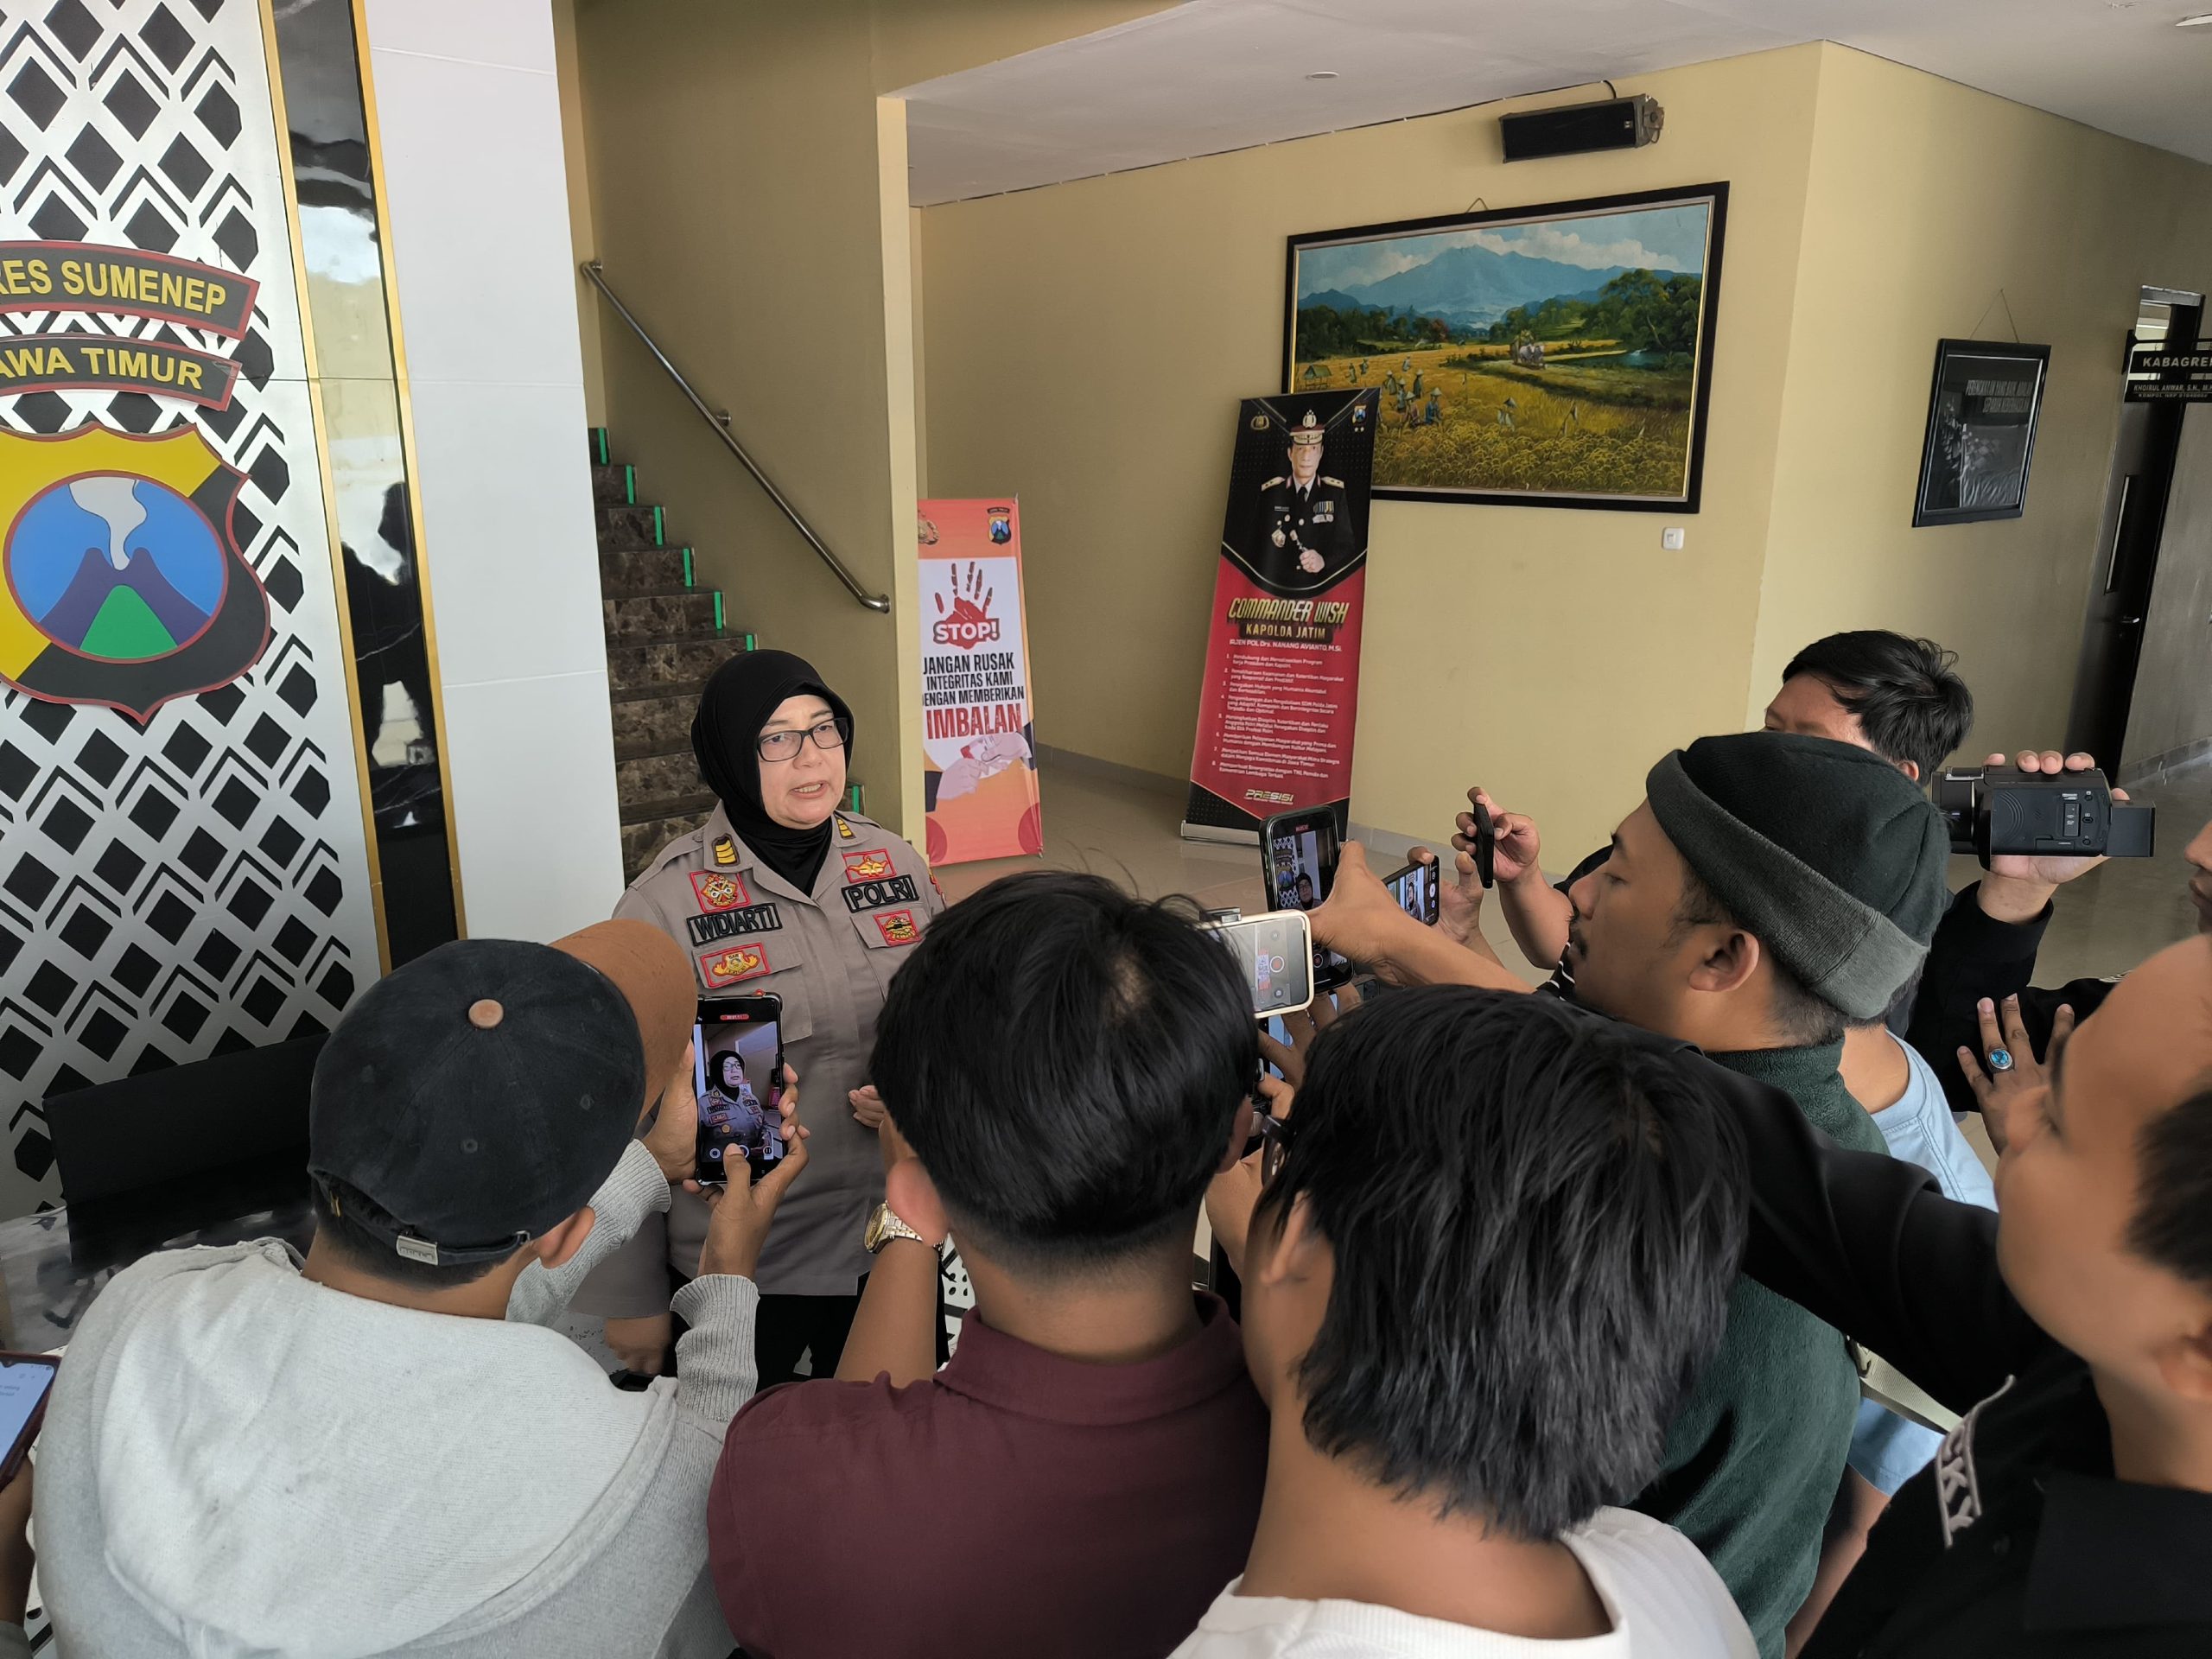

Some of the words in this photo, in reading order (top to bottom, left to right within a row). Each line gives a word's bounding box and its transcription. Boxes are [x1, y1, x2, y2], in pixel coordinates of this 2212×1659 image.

[61, 260, 226, 315] SUMENEP
[80, 347, 202, 390] TIMUR
[1228, 598, 1313, 622] COMMANDER
[1313, 601, 1350, 624] WISH
[936, 621, 998, 643] STOP!
[1246, 623, 1293, 638] KAPOLDA
[1295, 626, 1325, 639] JATIM
[923, 655, 970, 675] JANGAN
[974, 652, 1014, 671] RUSAK
[927, 672, 983, 690] INTEGRITAS
[985, 671, 1013, 686] KAMI
[923, 691, 956, 706] ENGAN
[958, 686, 1024, 704] MEMBERIKAN
[926, 702, 1023, 740] IMBALAN
[1245, 789, 1294, 802] PRESISI
[847, 879, 912, 907] POLRI
[694, 908, 774, 942] WIDIARTI
